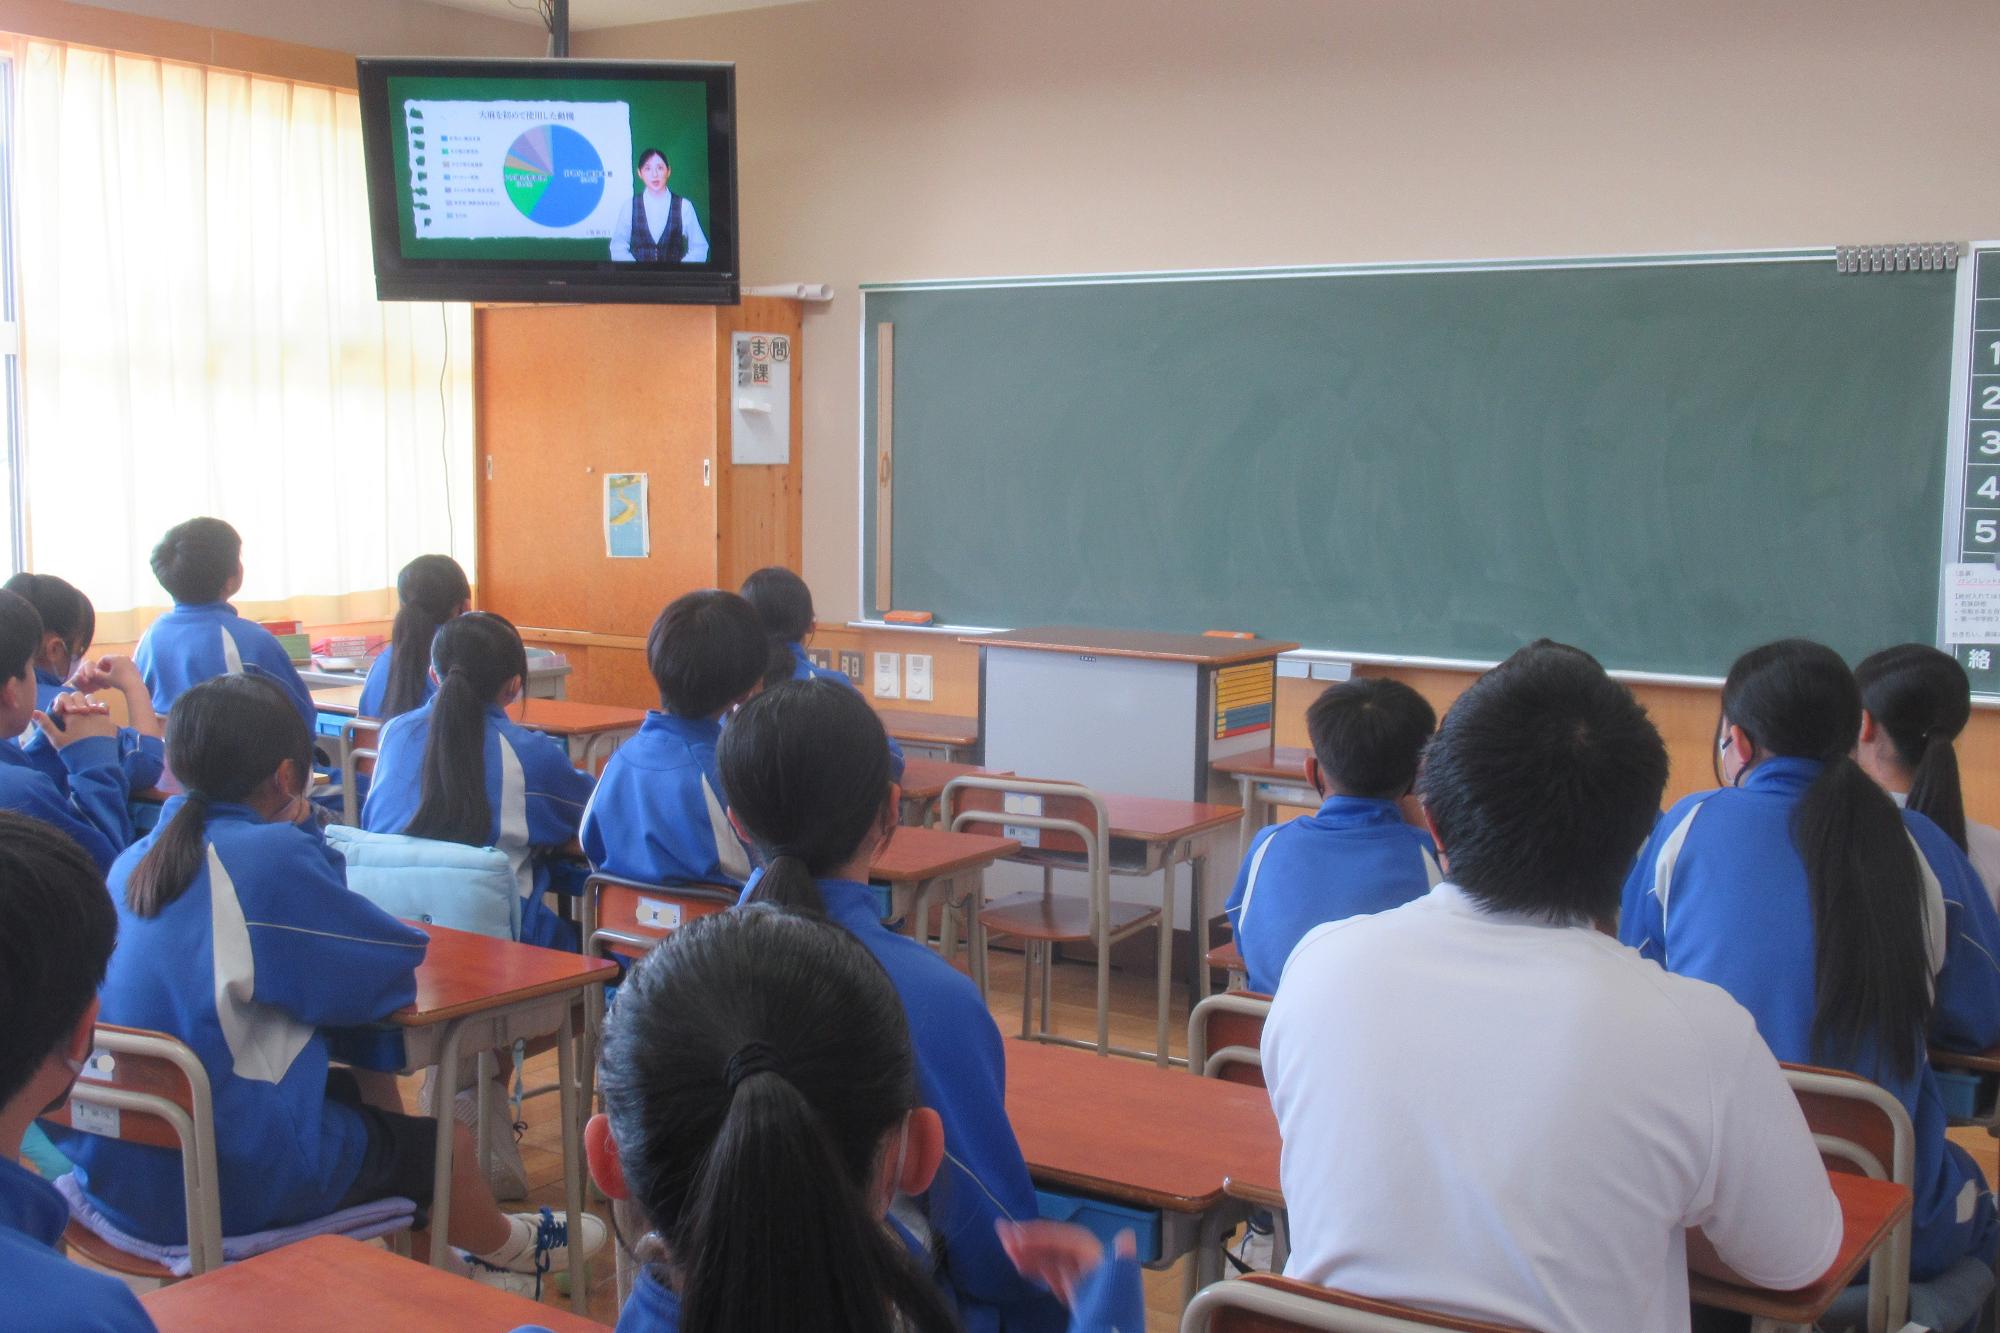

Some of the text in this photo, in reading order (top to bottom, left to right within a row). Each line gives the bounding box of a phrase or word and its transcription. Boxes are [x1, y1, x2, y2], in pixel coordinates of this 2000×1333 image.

[751, 337, 767, 358] ま
[772, 339, 788, 360] 問
[1990, 342, 2000, 365] 1
[753, 363, 768, 380] 課
[1983, 386, 2000, 410] 2
[1980, 430, 2000, 455] 3
[1977, 476, 2000, 499] 4
[1975, 520, 1997, 543] 5
